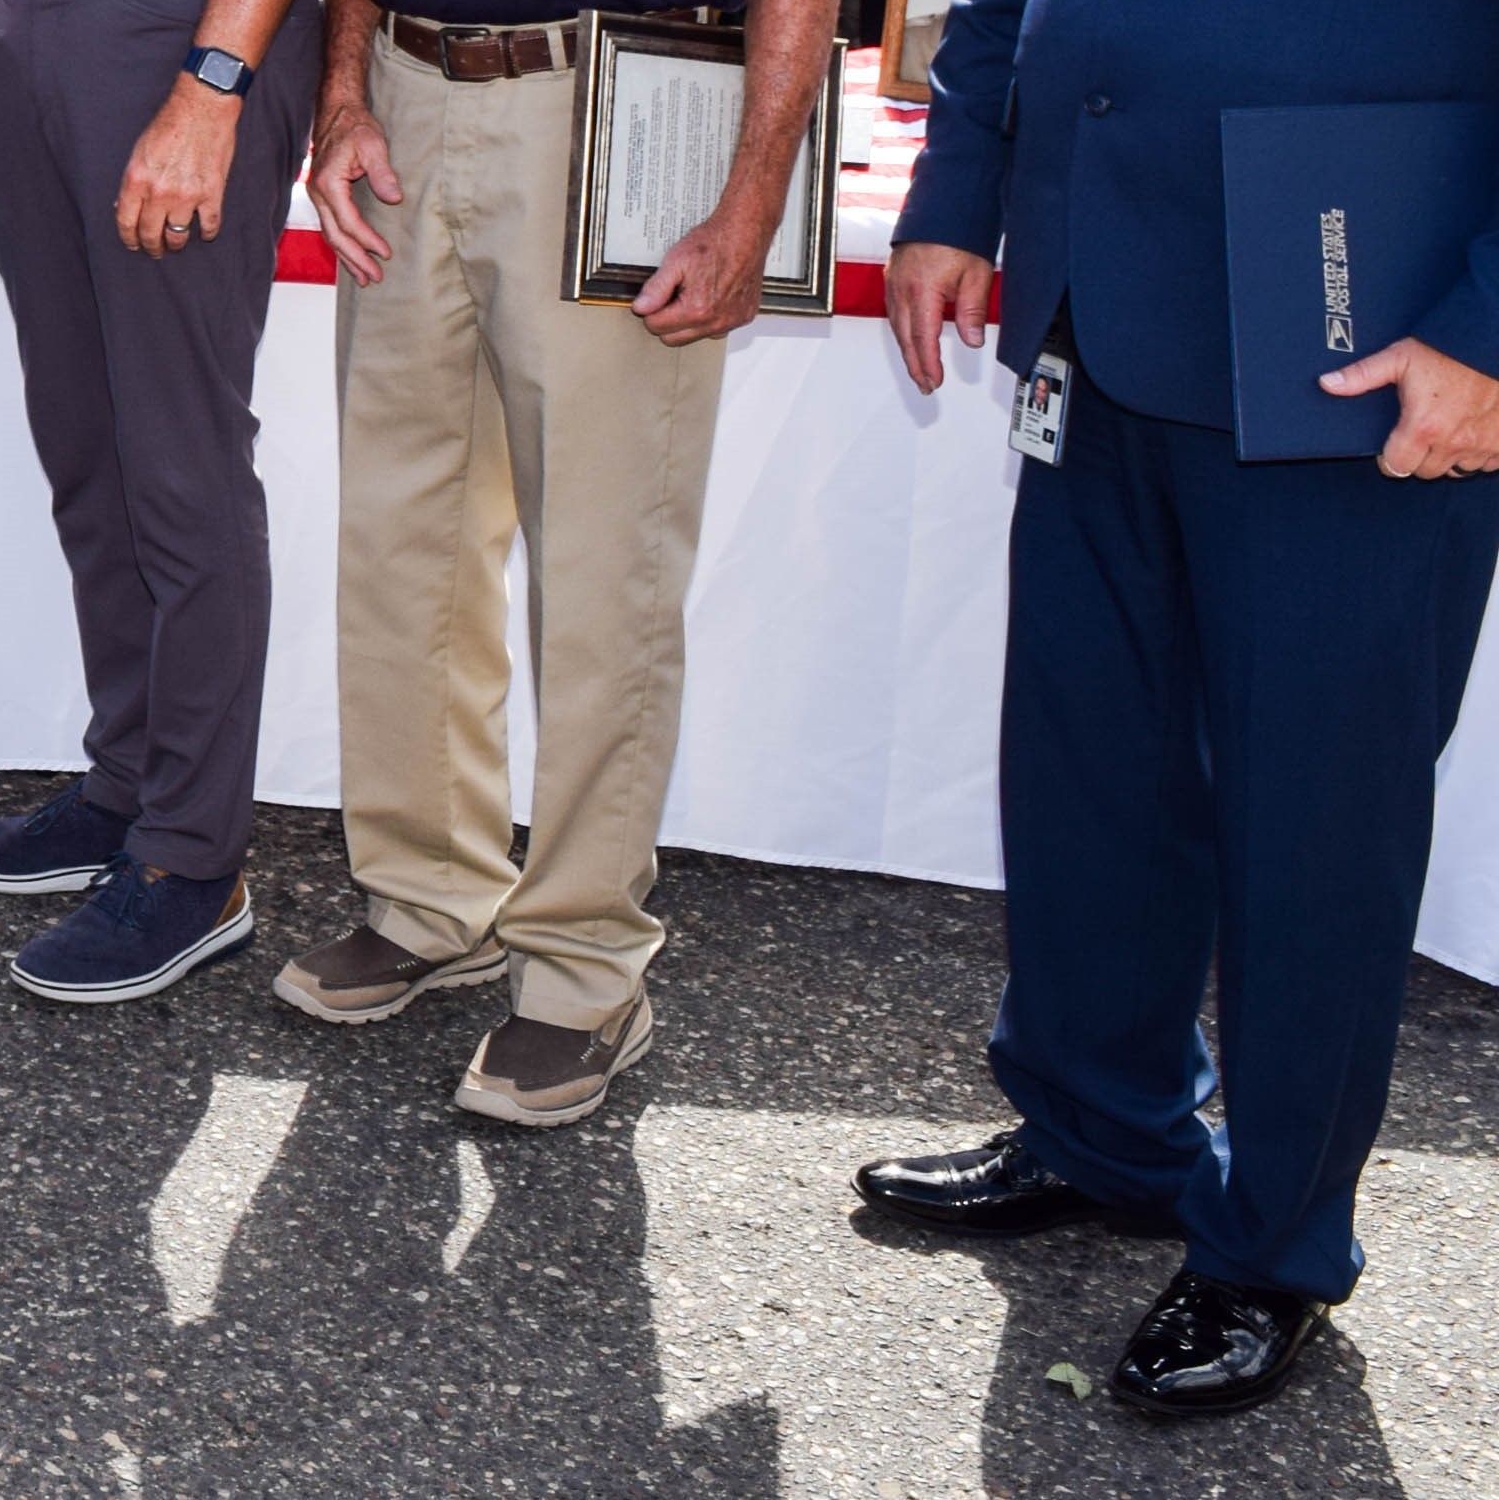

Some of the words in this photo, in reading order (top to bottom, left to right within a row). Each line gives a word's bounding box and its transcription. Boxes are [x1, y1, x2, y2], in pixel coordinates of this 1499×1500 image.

[1320, 212, 1334, 260] STATES
[1331, 208, 1347, 263] SERVICE
[1323, 261, 1337, 313] UNITED
[1336, 265, 1351, 315] POSTAL
